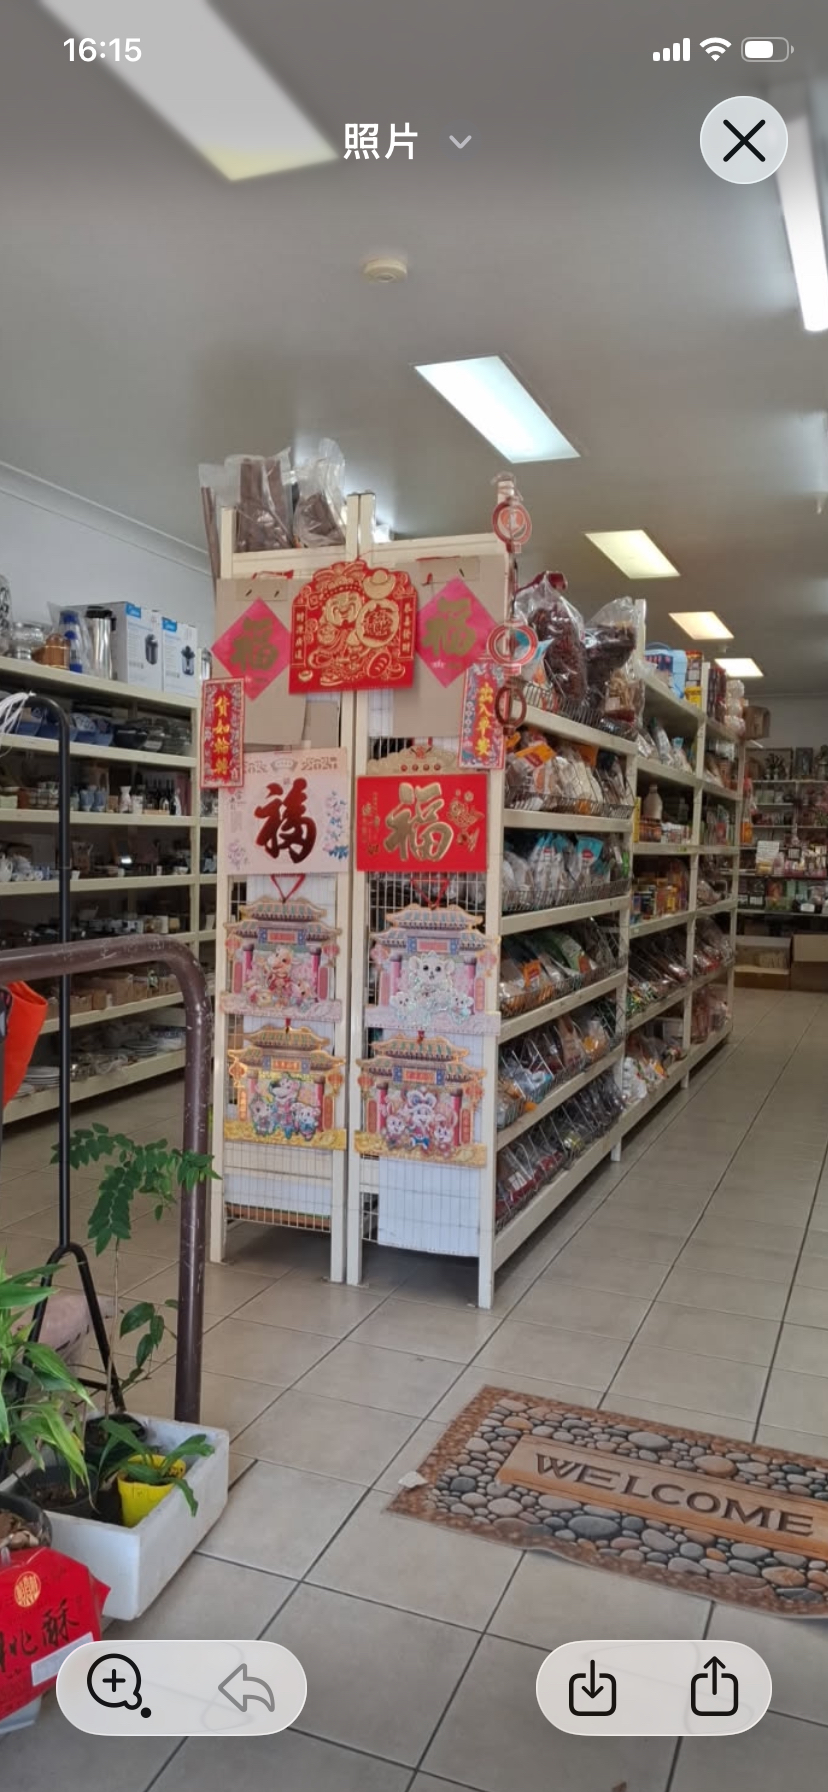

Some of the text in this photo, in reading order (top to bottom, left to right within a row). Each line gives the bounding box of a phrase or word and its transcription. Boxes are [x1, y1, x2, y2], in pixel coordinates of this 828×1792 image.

[230, 617, 279, 673] 福
[421, 597, 477, 656] 福
[383, 782, 455, 862] 福
[535, 1452, 814, 1537] WELCOME
